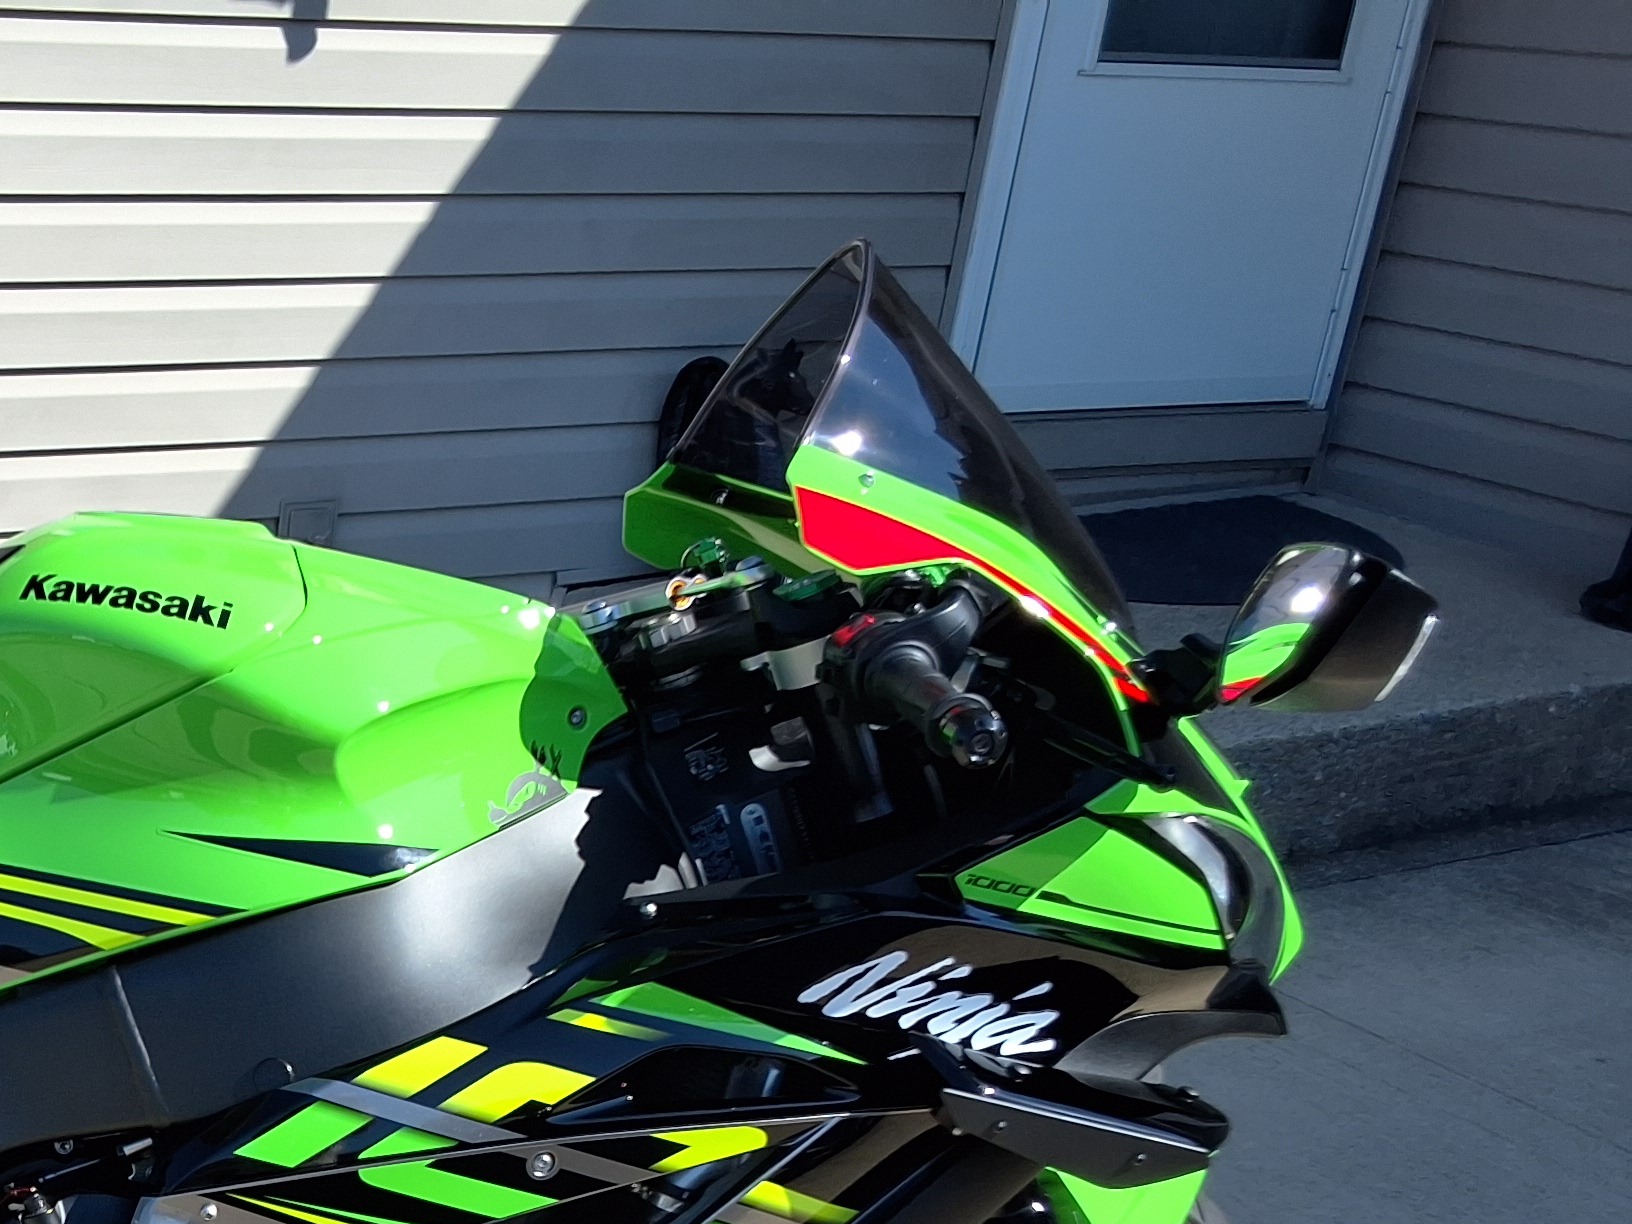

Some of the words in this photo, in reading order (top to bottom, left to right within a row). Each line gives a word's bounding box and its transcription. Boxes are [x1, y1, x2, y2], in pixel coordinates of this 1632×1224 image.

[18, 573, 233, 629] Kawasaki
[965, 874, 1037, 897] 1000
[797, 950, 1060, 1056] Ninja
